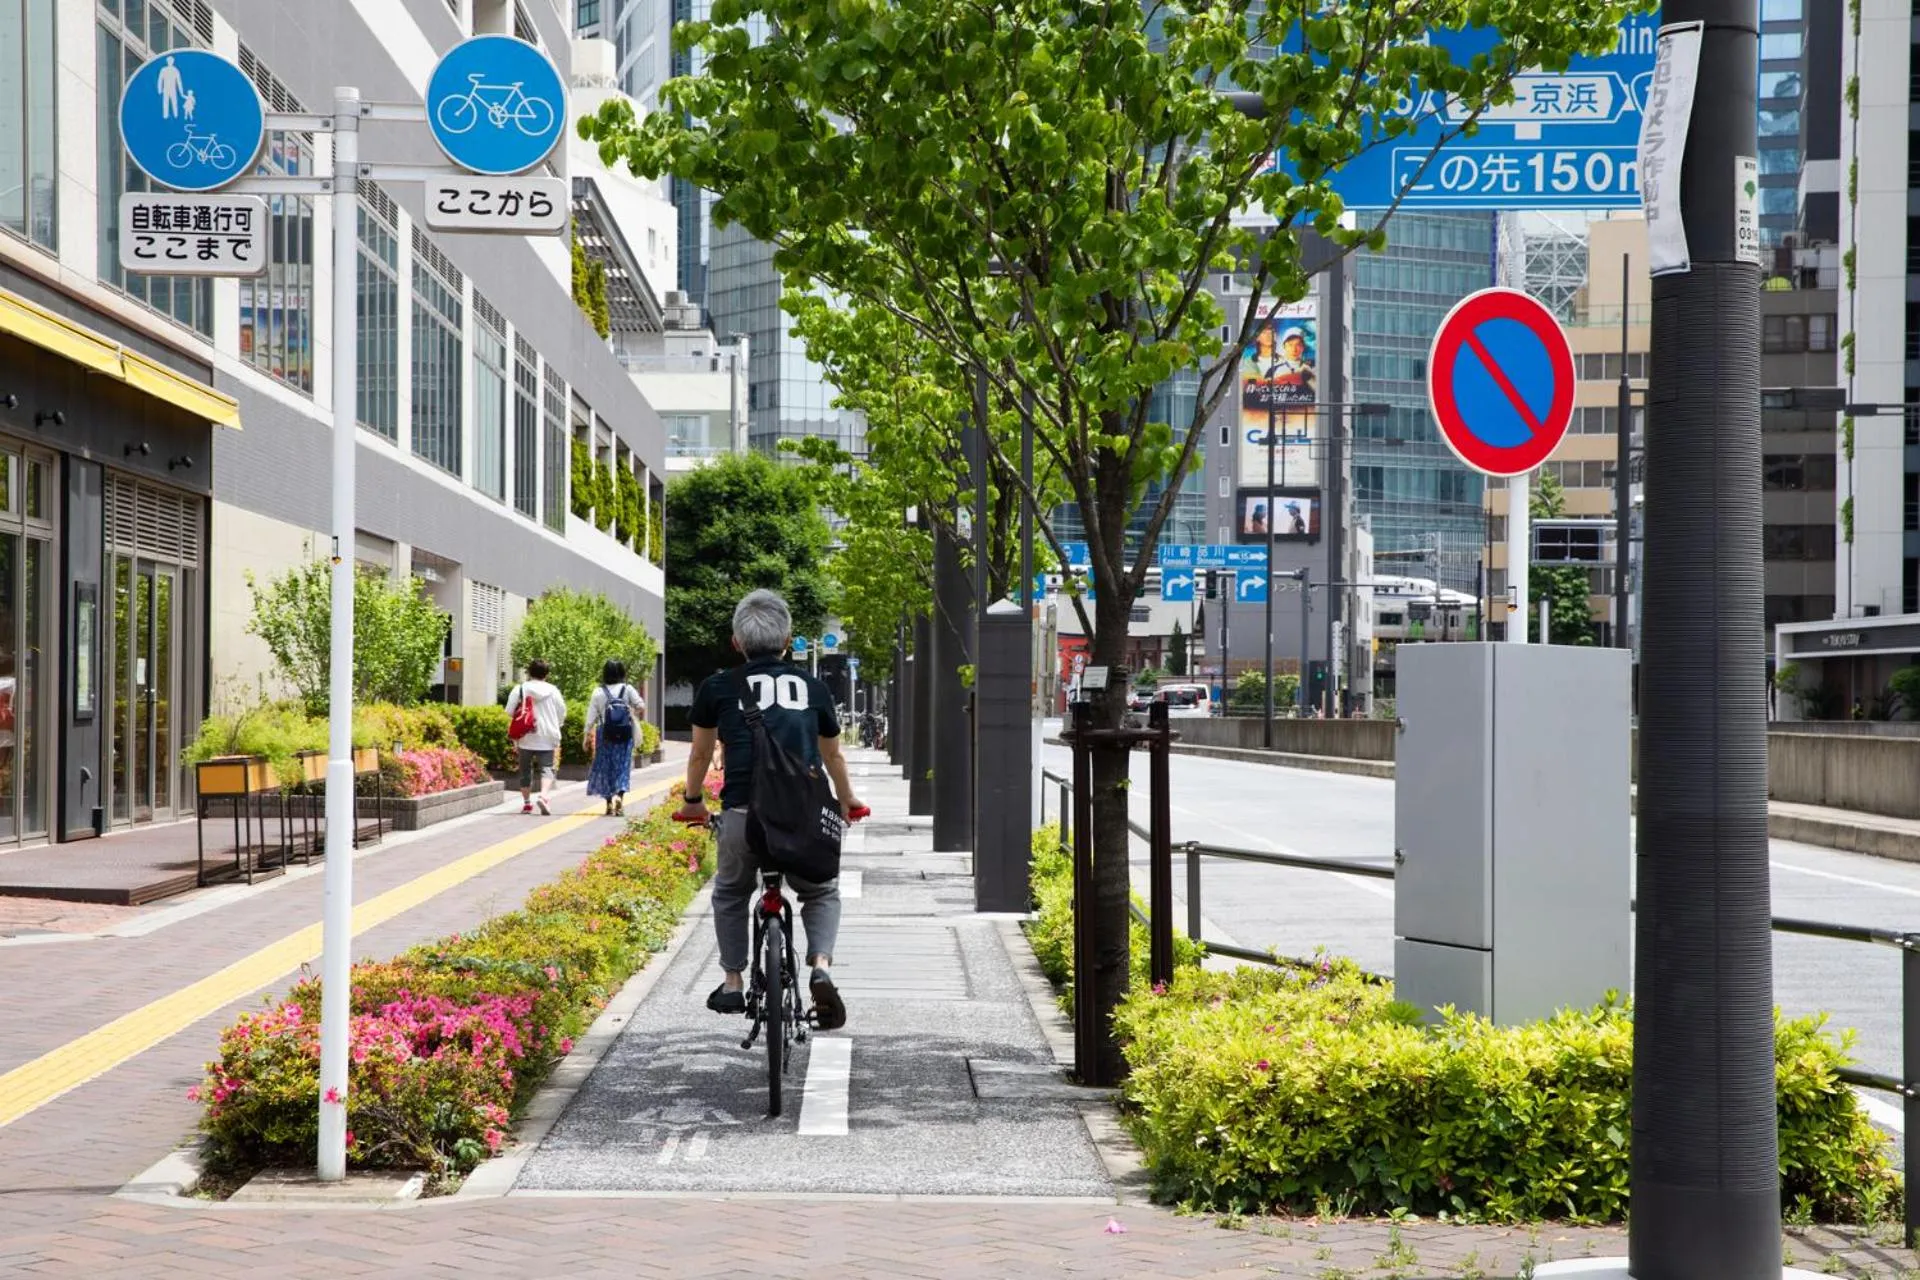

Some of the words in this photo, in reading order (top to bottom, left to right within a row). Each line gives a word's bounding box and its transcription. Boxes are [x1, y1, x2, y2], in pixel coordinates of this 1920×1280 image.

[437, 188, 554, 217] ここから
[132, 203, 253, 233] 自転車通行可
[134, 236, 252, 262] ここまで
